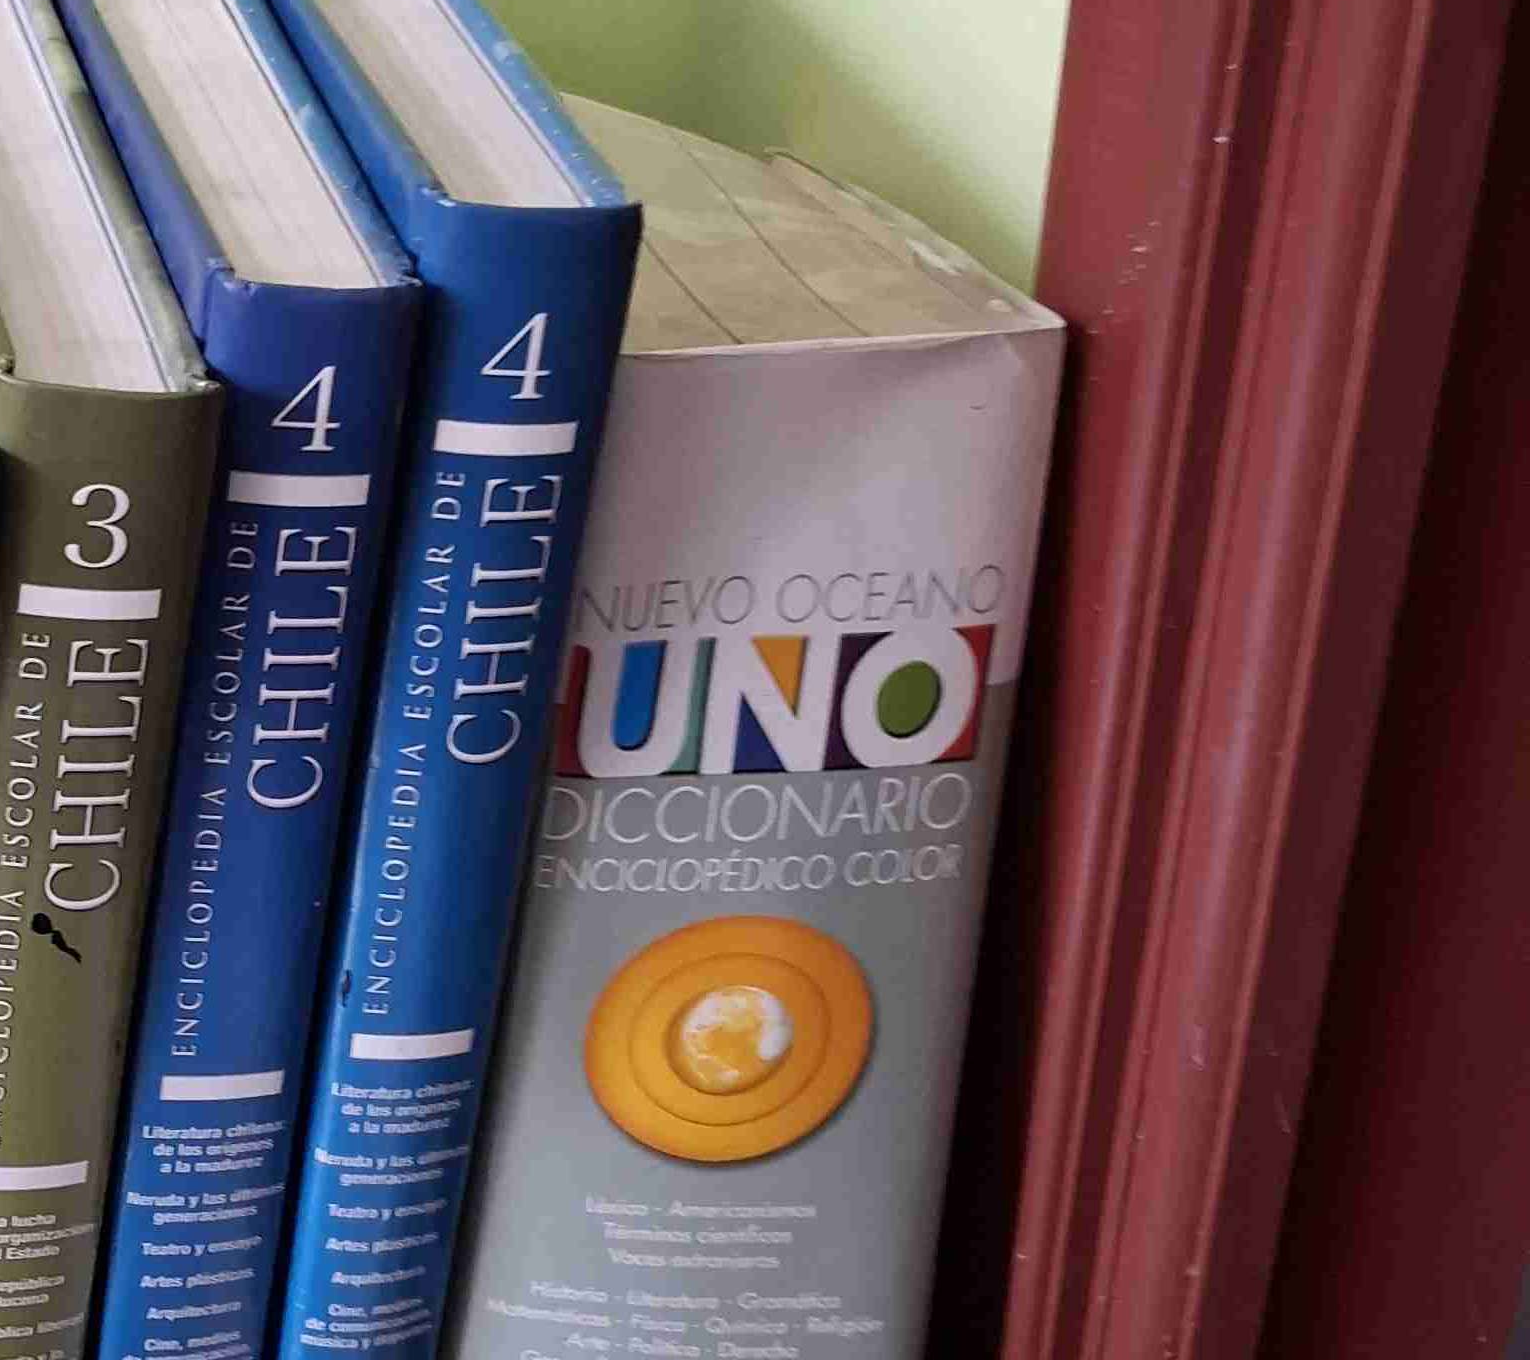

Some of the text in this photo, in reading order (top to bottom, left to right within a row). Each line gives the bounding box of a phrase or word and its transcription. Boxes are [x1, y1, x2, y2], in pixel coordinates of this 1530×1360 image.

[480, 312, 552, 400] 4
[271, 365, 341, 451] 4
[64, 484, 130, 568] 3
[447, 474, 563, 764] CHILE
[572, 564, 1005, 632] NUEVO OCEANO
[19, 632, 50, 680] DE
[247, 526, 358, 808] CHILE
[362, 471, 466, 1015] ENCICLOPEDIA ESCOLAR DE
[570, 625, 986, 778] UNO
[0, 702, 43, 868] ESCOLAR
[44, 639, 149, 911] CHILE
[171, 522, 259, 1056] ENCICLOPEDIA ESCOLAR DE
[544, 772, 971, 842] DICCIONARIO
[535, 843, 963, 893] ENCICLOPÉDICO COLOR
[5, 1245, 61, 1260] Estado
[11, 1214, 56, 1227] lucha
